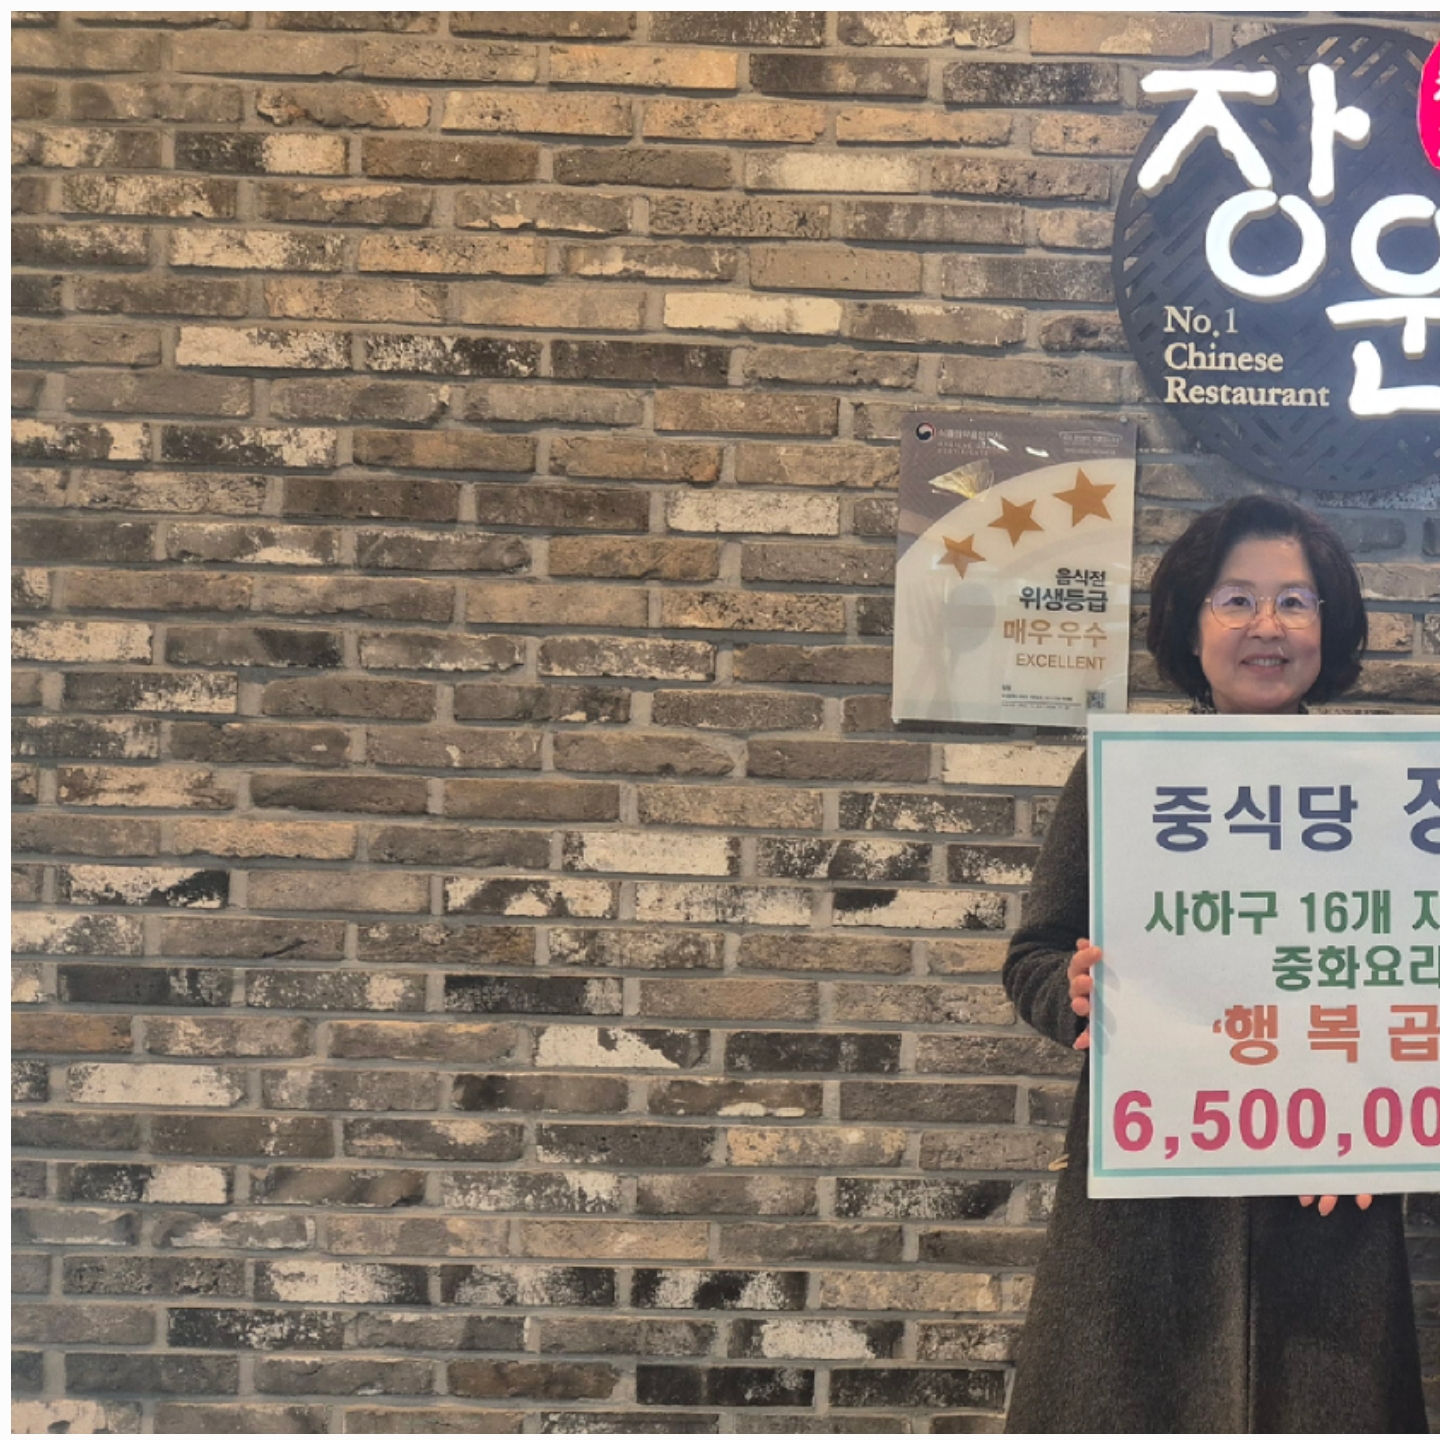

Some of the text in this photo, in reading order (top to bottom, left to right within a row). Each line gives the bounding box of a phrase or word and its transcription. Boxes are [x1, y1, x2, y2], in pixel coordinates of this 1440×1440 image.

[1164, 342, 1284, 372] Chinese
[1164, 376, 1331, 407] Restaurant
[1055, 567, 1106, 587] 음식점
[1019, 586, 1108, 613] 위생등급
[1003, 618, 1108, 648] 매우 우수
[1016, 653, 1107, 671] EXCELLENT
[1152, 785, 1359, 853] 중식당
[1144, 890, 1279, 936] 사하구
[1299, 889, 1391, 934] 16개
